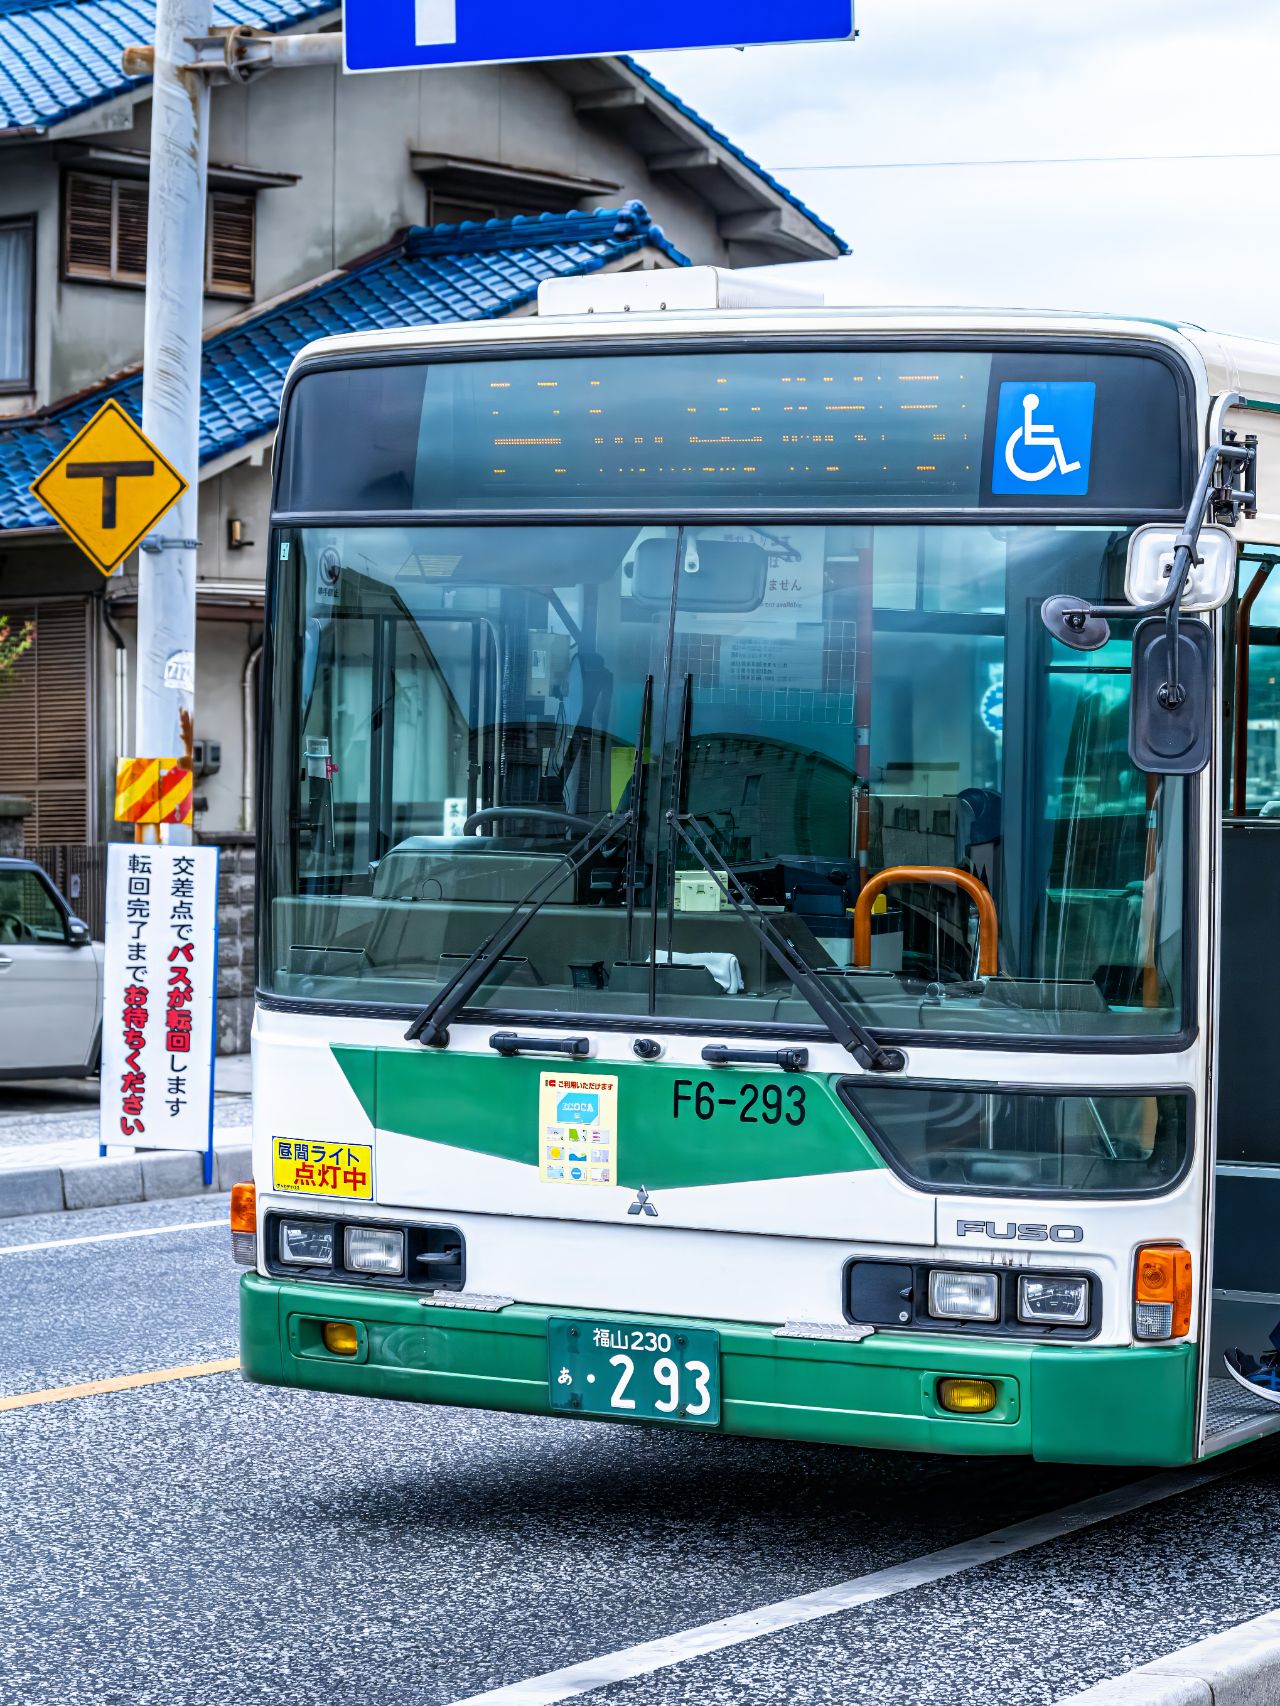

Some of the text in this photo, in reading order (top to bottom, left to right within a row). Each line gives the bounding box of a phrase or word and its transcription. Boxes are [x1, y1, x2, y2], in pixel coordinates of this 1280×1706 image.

[120, 853, 152, 1136] 転回完了までお待ちください
[165, 855, 196, 1117] 交差点でバスが転回します
[558, 1080, 614, 1091] ご利用いただけます
[673, 1079, 806, 1127] F6-293
[278, 1141, 360, 1167] 昼間ライト
[293, 1162, 367, 1192] 点灯中
[956, 1219, 1084, 1243] FUSO
